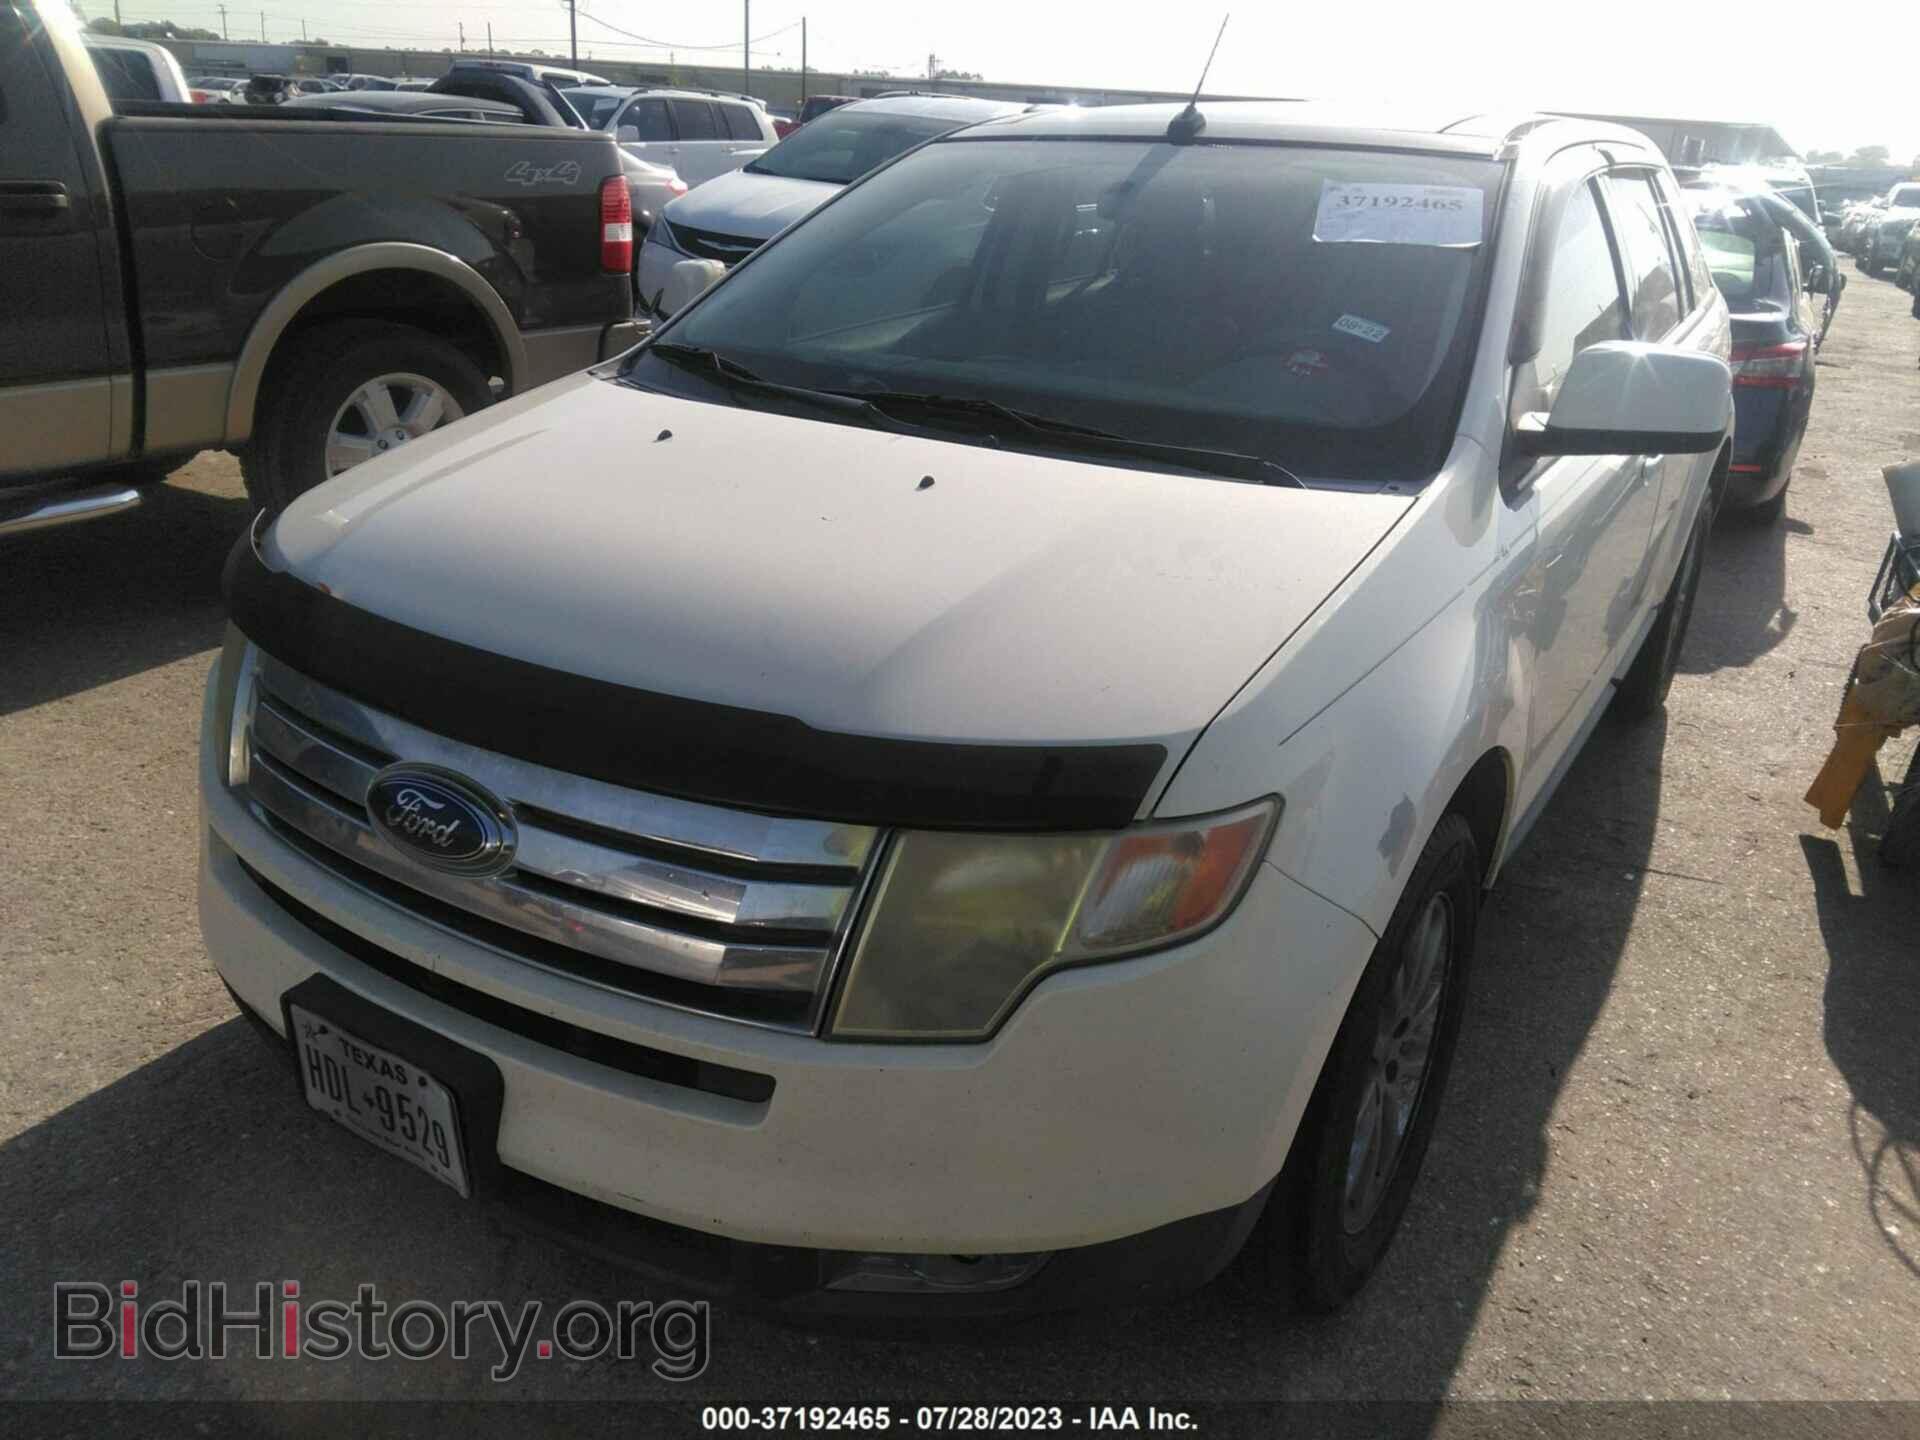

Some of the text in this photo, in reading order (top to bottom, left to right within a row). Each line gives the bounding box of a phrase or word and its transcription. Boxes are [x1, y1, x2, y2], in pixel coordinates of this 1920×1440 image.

[1335, 193, 1466, 213] 37192465
[386, 788, 461, 848] Ford
[338, 1037, 409, 1086] TEXAS
